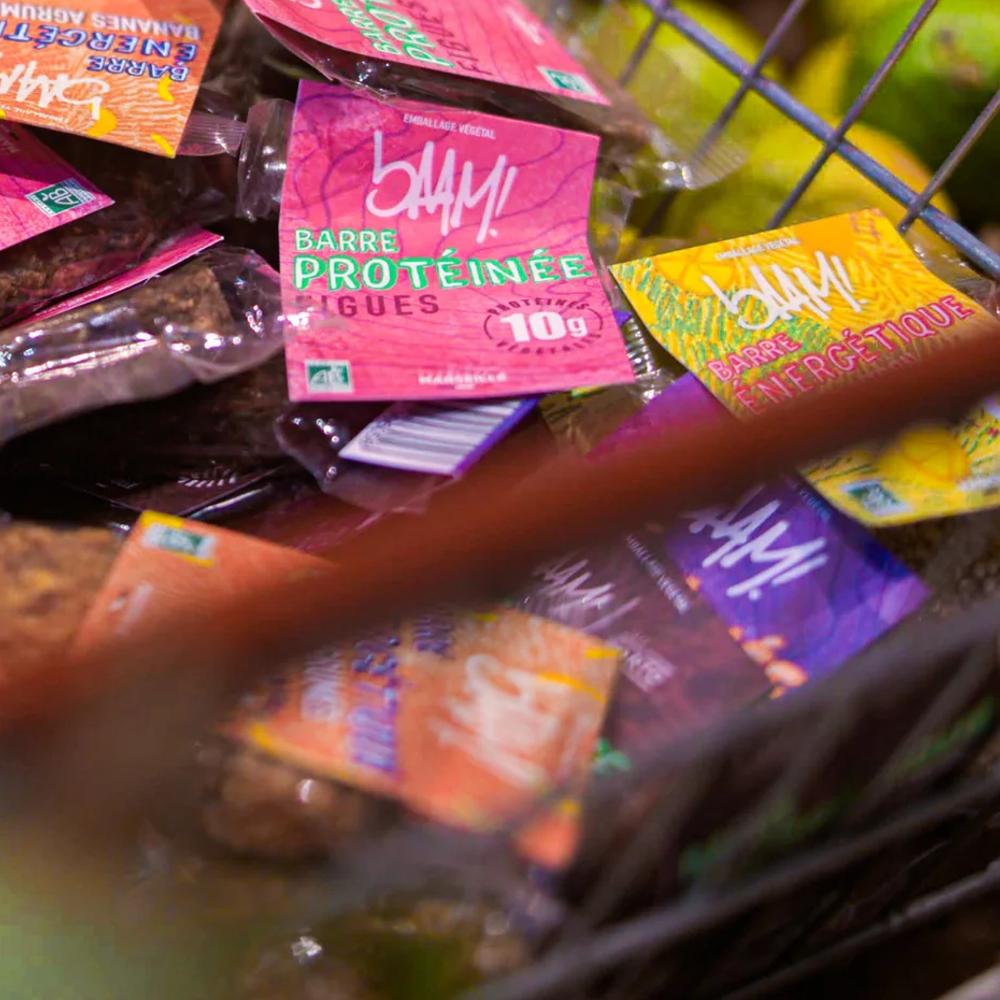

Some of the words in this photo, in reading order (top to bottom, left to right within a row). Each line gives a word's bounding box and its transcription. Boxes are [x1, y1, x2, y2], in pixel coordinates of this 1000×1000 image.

[91, 12, 200, 44] BANANES
[86, 55, 191, 82] BARRE
[402, 113, 456, 133] EMBALLAGE
[294, 228, 399, 253] BARRE
[293, 248, 593, 291] PROTÉINÉE
[500, 310, 588, 343] 10g
[705, 332, 801, 384] BARRE
[732, 294, 976, 416] ÉNERGÉTIQUE
